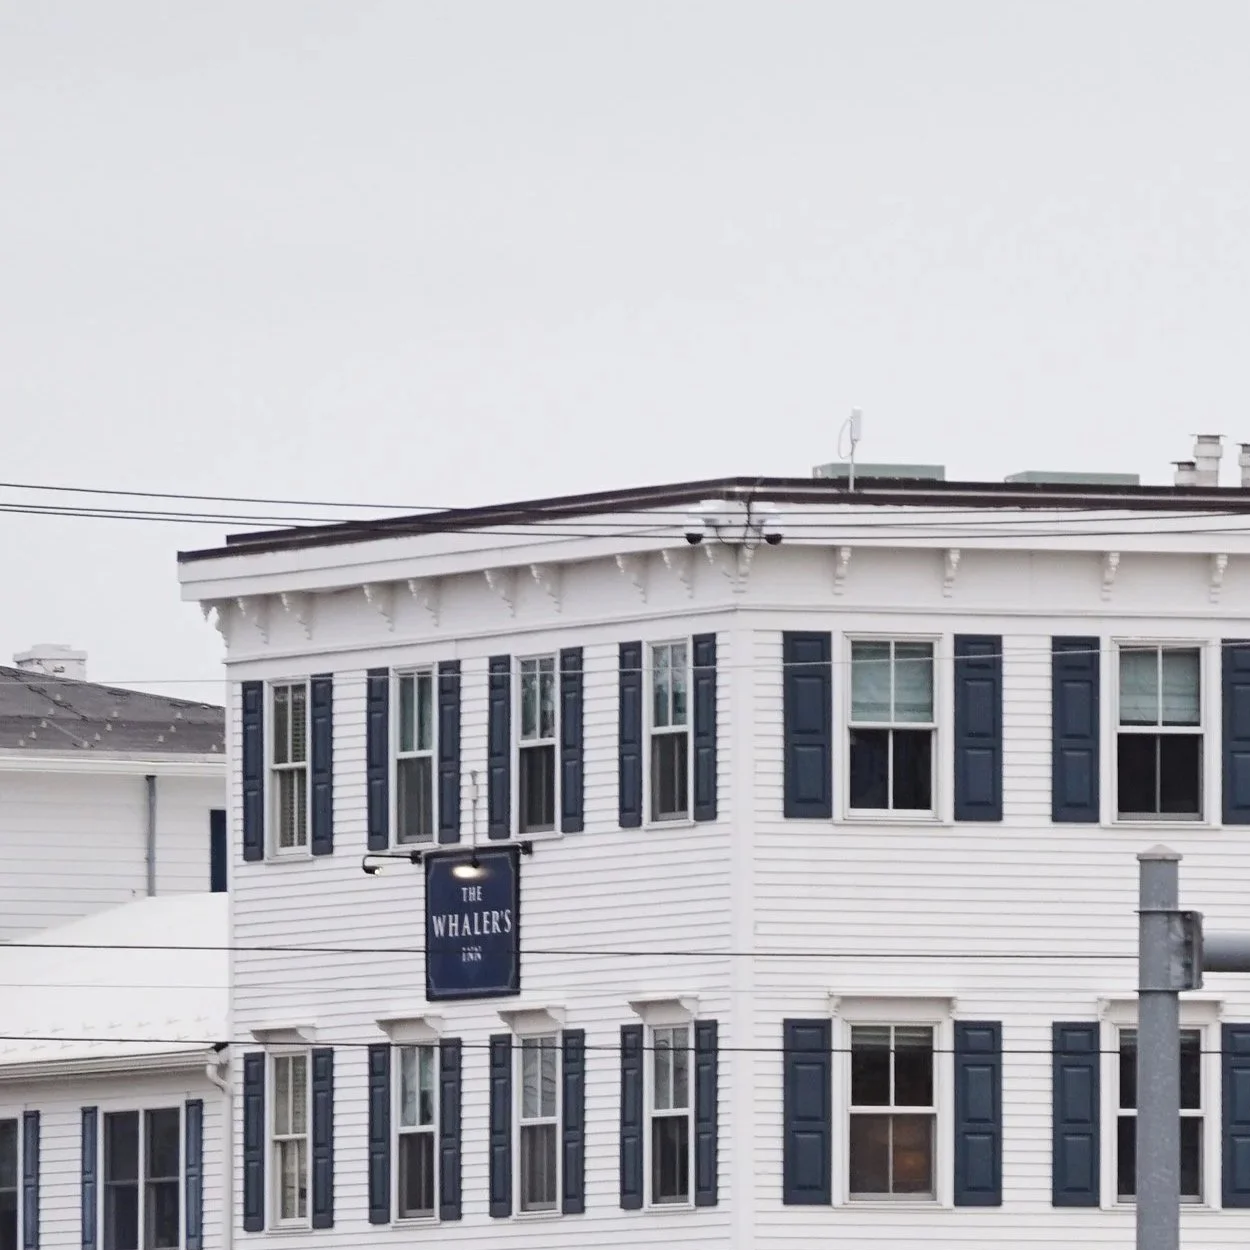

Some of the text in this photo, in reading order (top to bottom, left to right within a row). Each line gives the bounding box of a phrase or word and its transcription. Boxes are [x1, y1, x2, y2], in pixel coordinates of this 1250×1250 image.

[461, 886, 483, 903] THE
[432, 909, 512, 938] WHALER'S
[461, 945, 482, 962] INN
